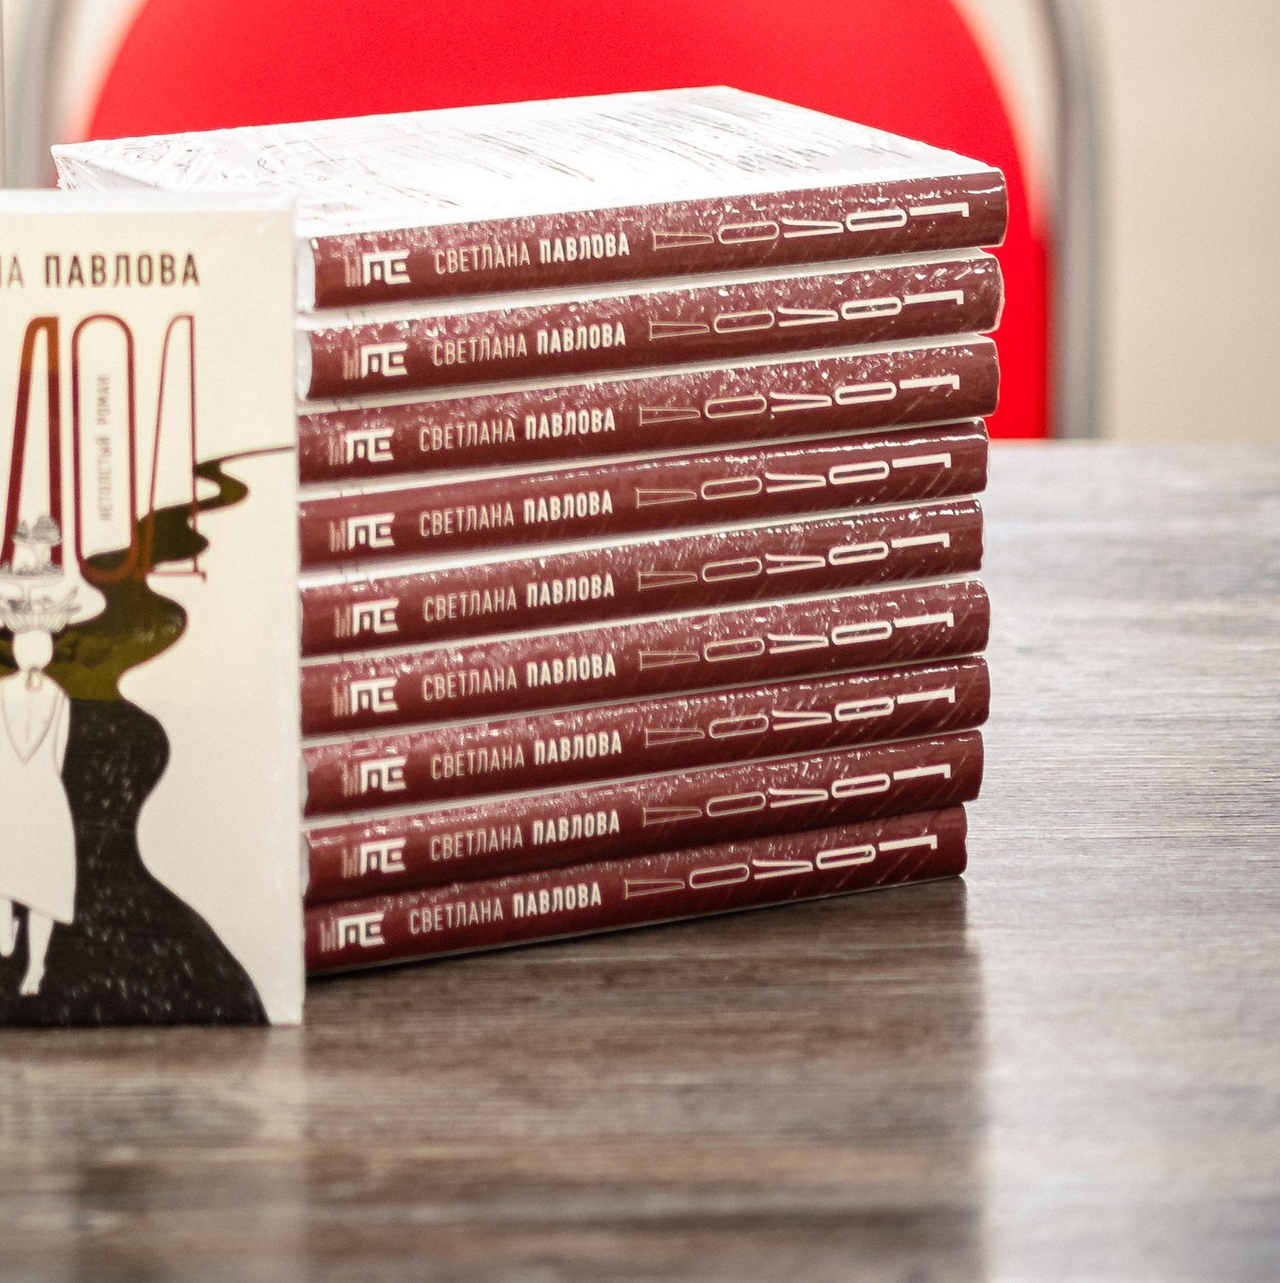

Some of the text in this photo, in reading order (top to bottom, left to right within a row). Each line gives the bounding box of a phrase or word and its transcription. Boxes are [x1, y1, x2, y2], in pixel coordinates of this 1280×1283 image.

[44, 253, 200, 288] ПАВЛОВА
[434, 233, 630, 275] СВЕТЛАНА ПАВЛОВА
[432, 323, 626, 367] СВЕТЛАНА ПАВЛОВА
[419, 406, 616, 453] СВЕТЛАНА ПАВЛОВА
[420, 491, 613, 537] СВЕТЛАНА ПАВЛОВА
[423, 574, 615, 622] СВЕТЛАНА ПАВЛОВА
[422, 655, 617, 702] СВЕТЛАНА ПАВЛОВА
[430, 731, 623, 780] СВЕТЛАНА ПАВЛОВА
[430, 810, 620, 860] СВЕТЛАНА ПАВЛОВА
[409, 883, 602, 935] СВЕТЛАНА ПАВЛОВА
